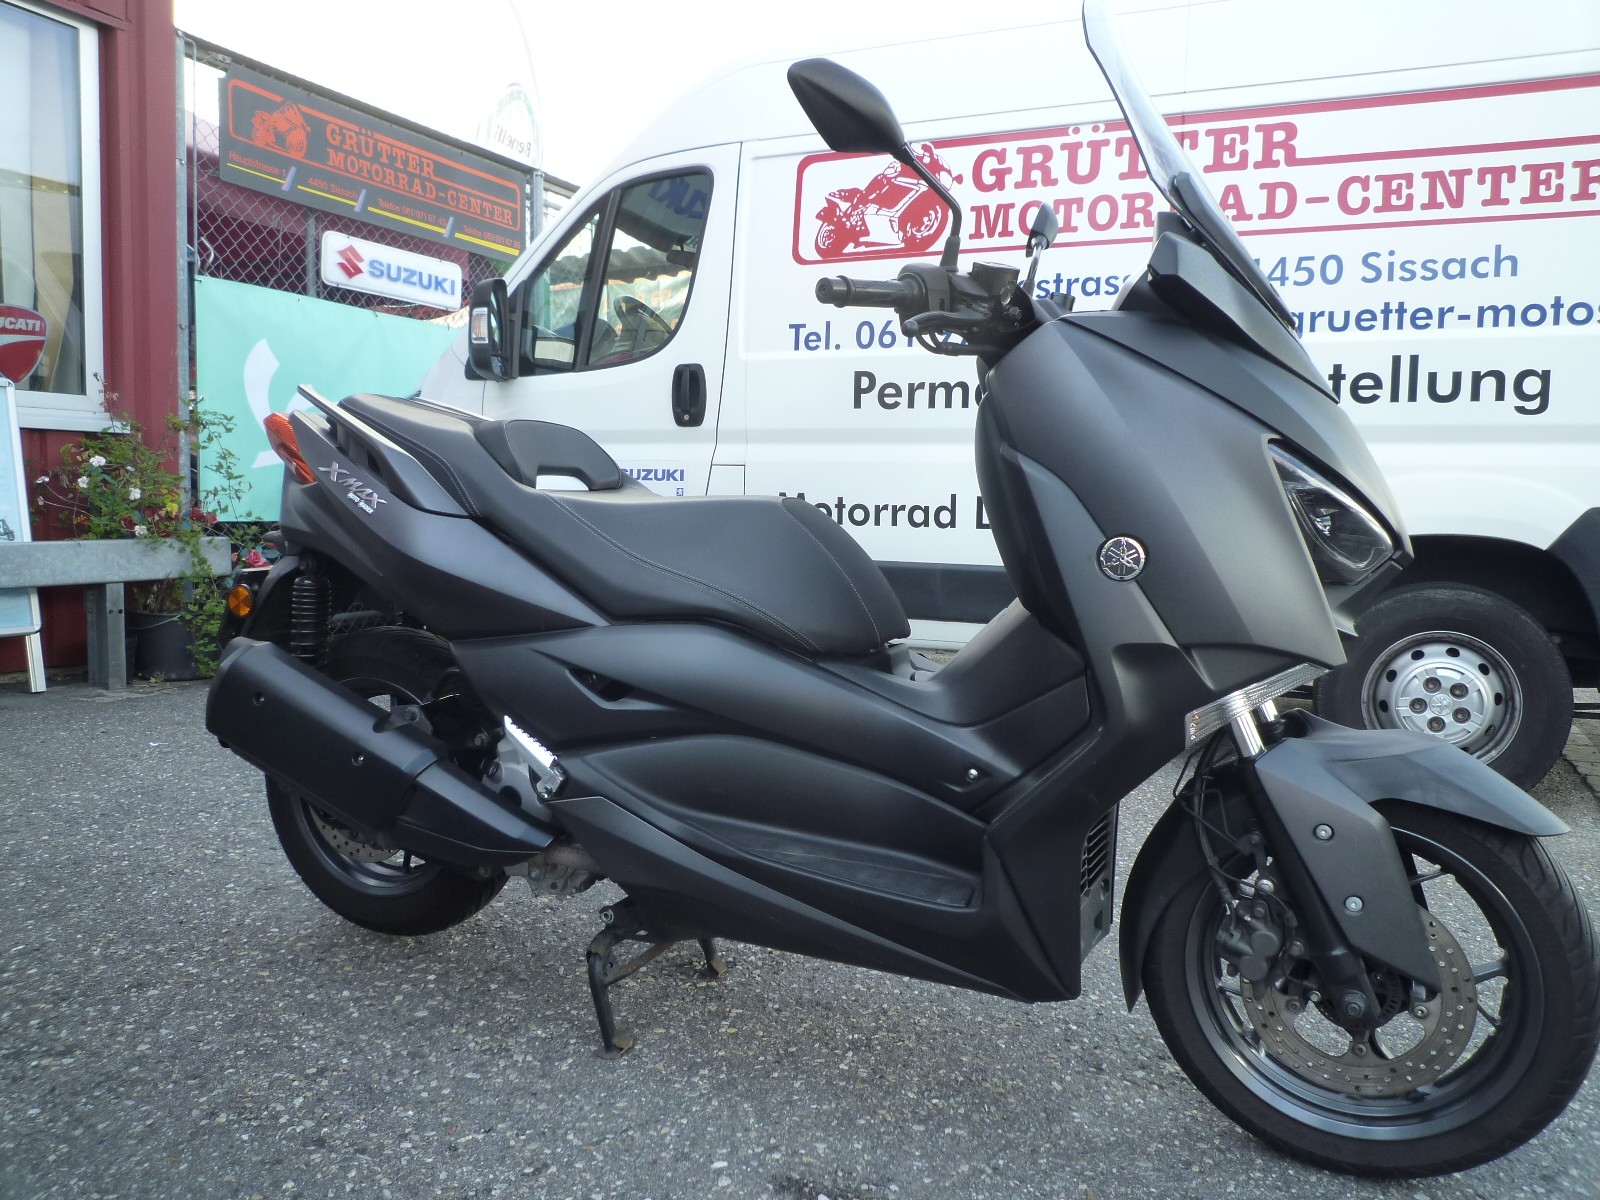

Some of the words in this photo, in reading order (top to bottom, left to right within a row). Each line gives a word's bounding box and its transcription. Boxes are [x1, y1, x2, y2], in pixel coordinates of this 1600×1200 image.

[326, 123, 435, 178] GRÜTTER
[327, 149, 513, 225] MOTORRAD-CENTER
[368, 258, 456, 296] SUZUKI
[1253, 254, 1345, 288] 450
[1360, 243, 1519, 284] Sissach
[788, 320, 841, 352] Tel.
